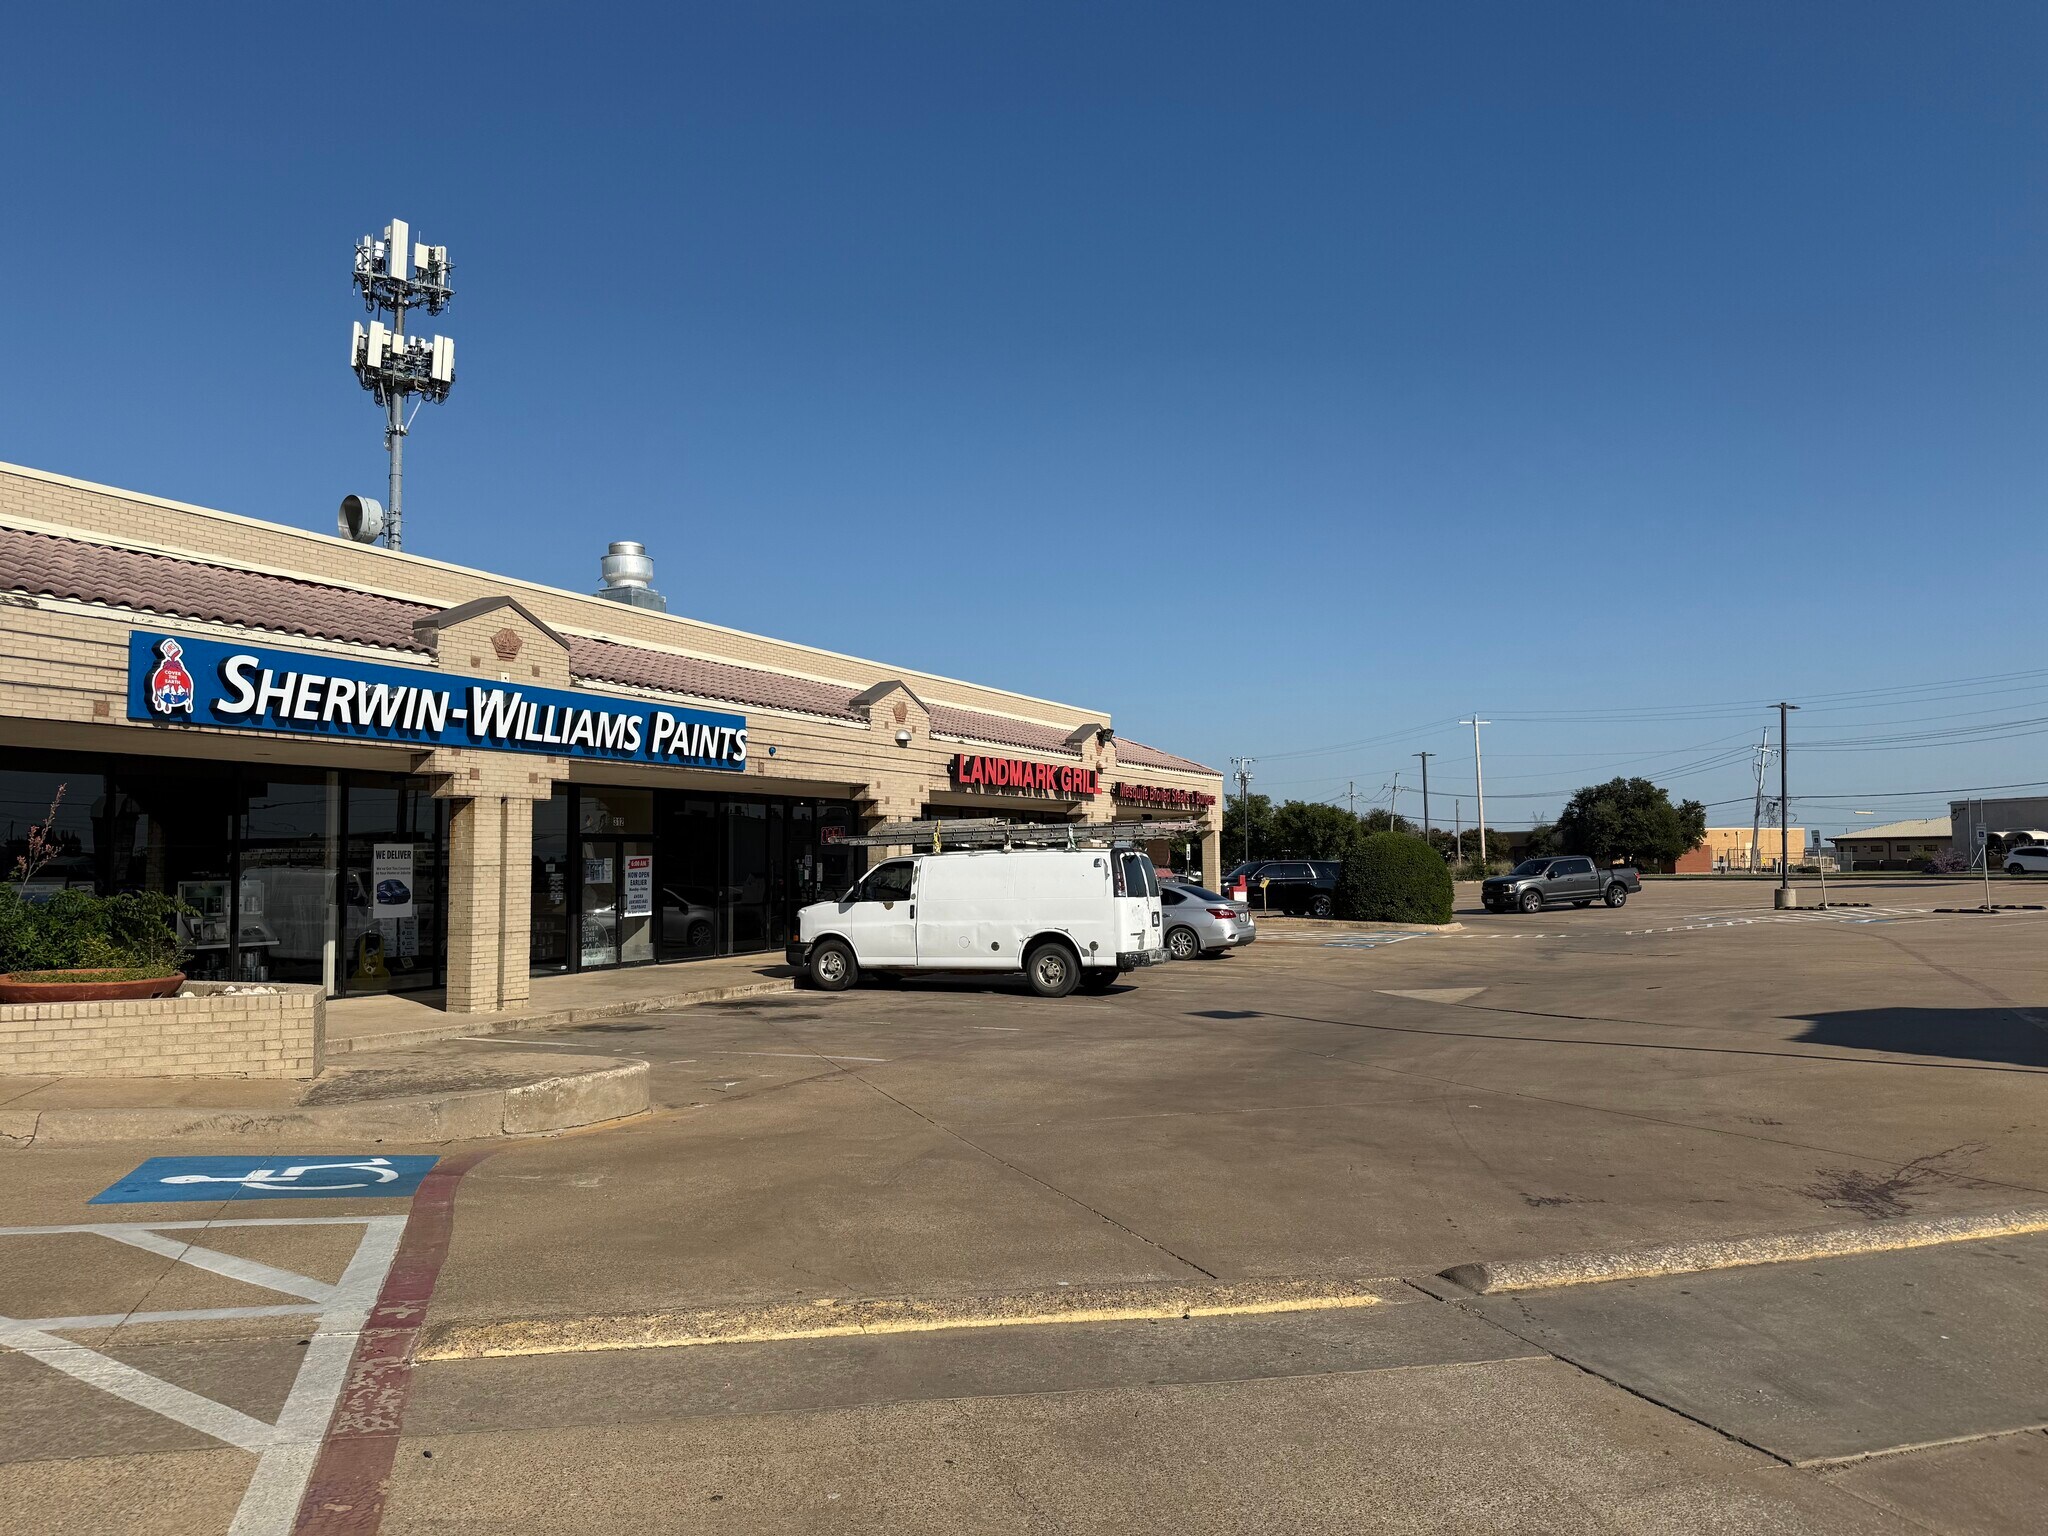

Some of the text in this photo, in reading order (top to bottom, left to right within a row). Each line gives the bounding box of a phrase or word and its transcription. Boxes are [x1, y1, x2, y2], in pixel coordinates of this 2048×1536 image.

[217, 654, 748, 762] SHERWIN-WILLIAMS PAINTS
[959, 753, 1103, 795] LANDMARK GRILL
[1119, 782, 1149, 800] Mesquite
[1171, 787, 1190, 804] Steaks
[375, 850, 412, 860] WE DELIVER
[581, 925, 599, 933] COVER
